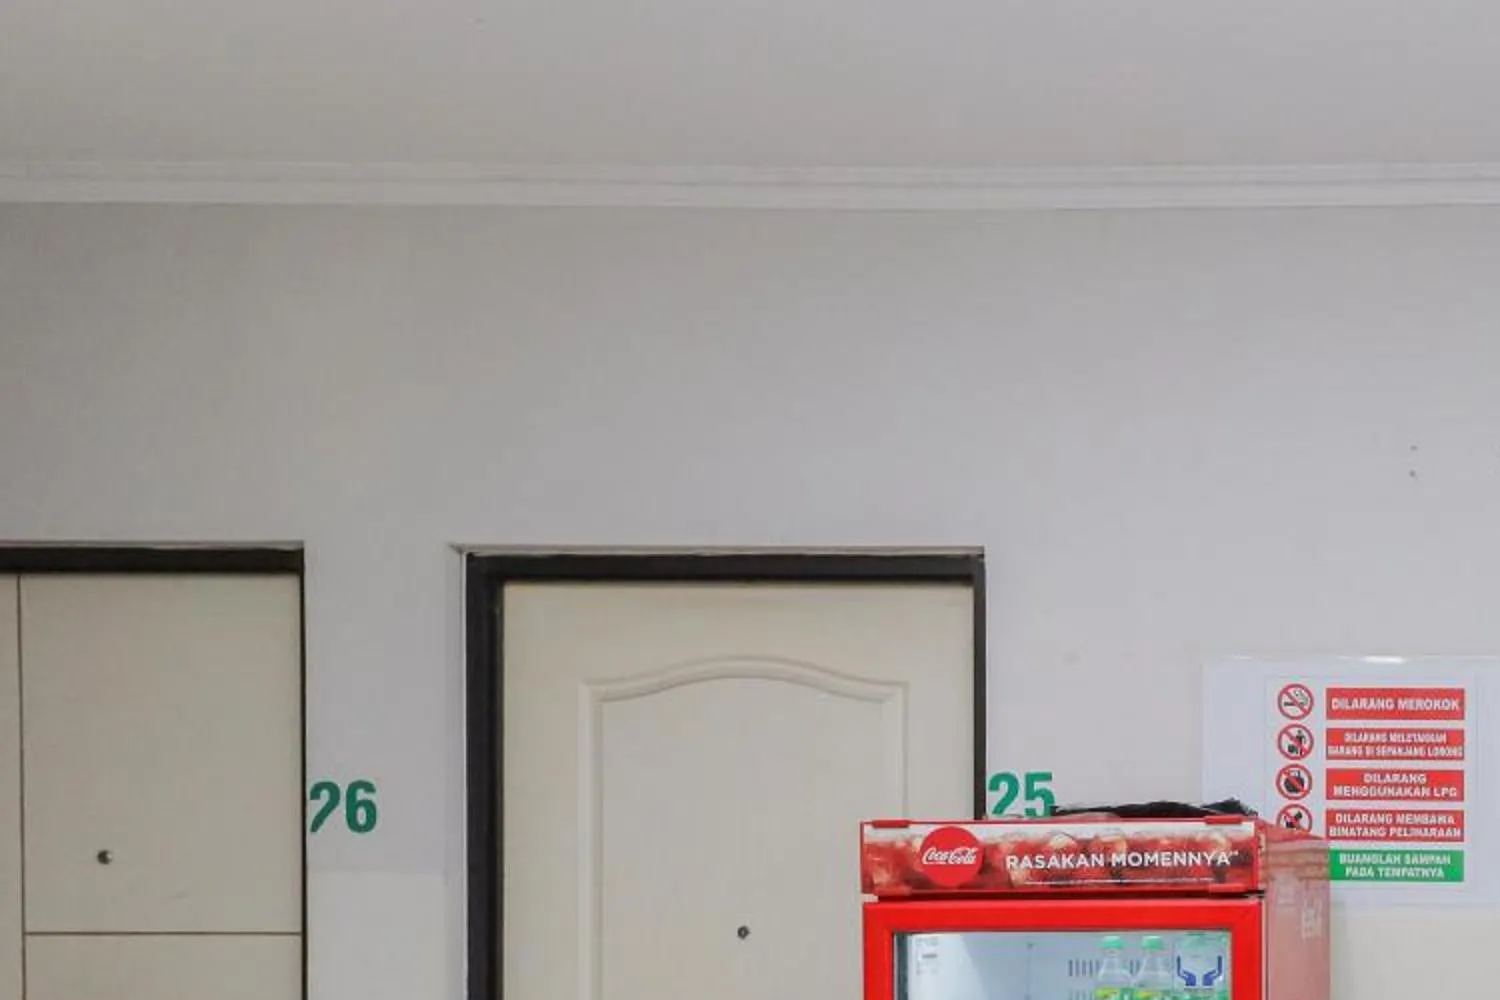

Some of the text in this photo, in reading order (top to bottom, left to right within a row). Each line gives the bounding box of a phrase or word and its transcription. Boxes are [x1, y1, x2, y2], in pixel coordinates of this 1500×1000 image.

[1331, 698, 1459, 710] DILARANG MEROKOK
[1343, 732, 1387, 742] DILARANG
[1363, 773, 1427, 784] DILARANG
[989, 772, 1055, 817] 25
[1333, 785, 1457, 797] MENGGUNAKAN LPG
[310, 780, 376, 833] 26
[1335, 813, 1455, 825] DILARANG MEMBAWA
[1329, 826, 1461, 838] BINATANG PELIHARAAN
[922, 847, 978, 865] Coca-Cola
[1005, 852, 1105, 870] RASAKAN
[1339, 853, 1451, 865] BUANGLAH SAMPAH
[1345, 867, 1445, 878] PADA TEMPATNYA
